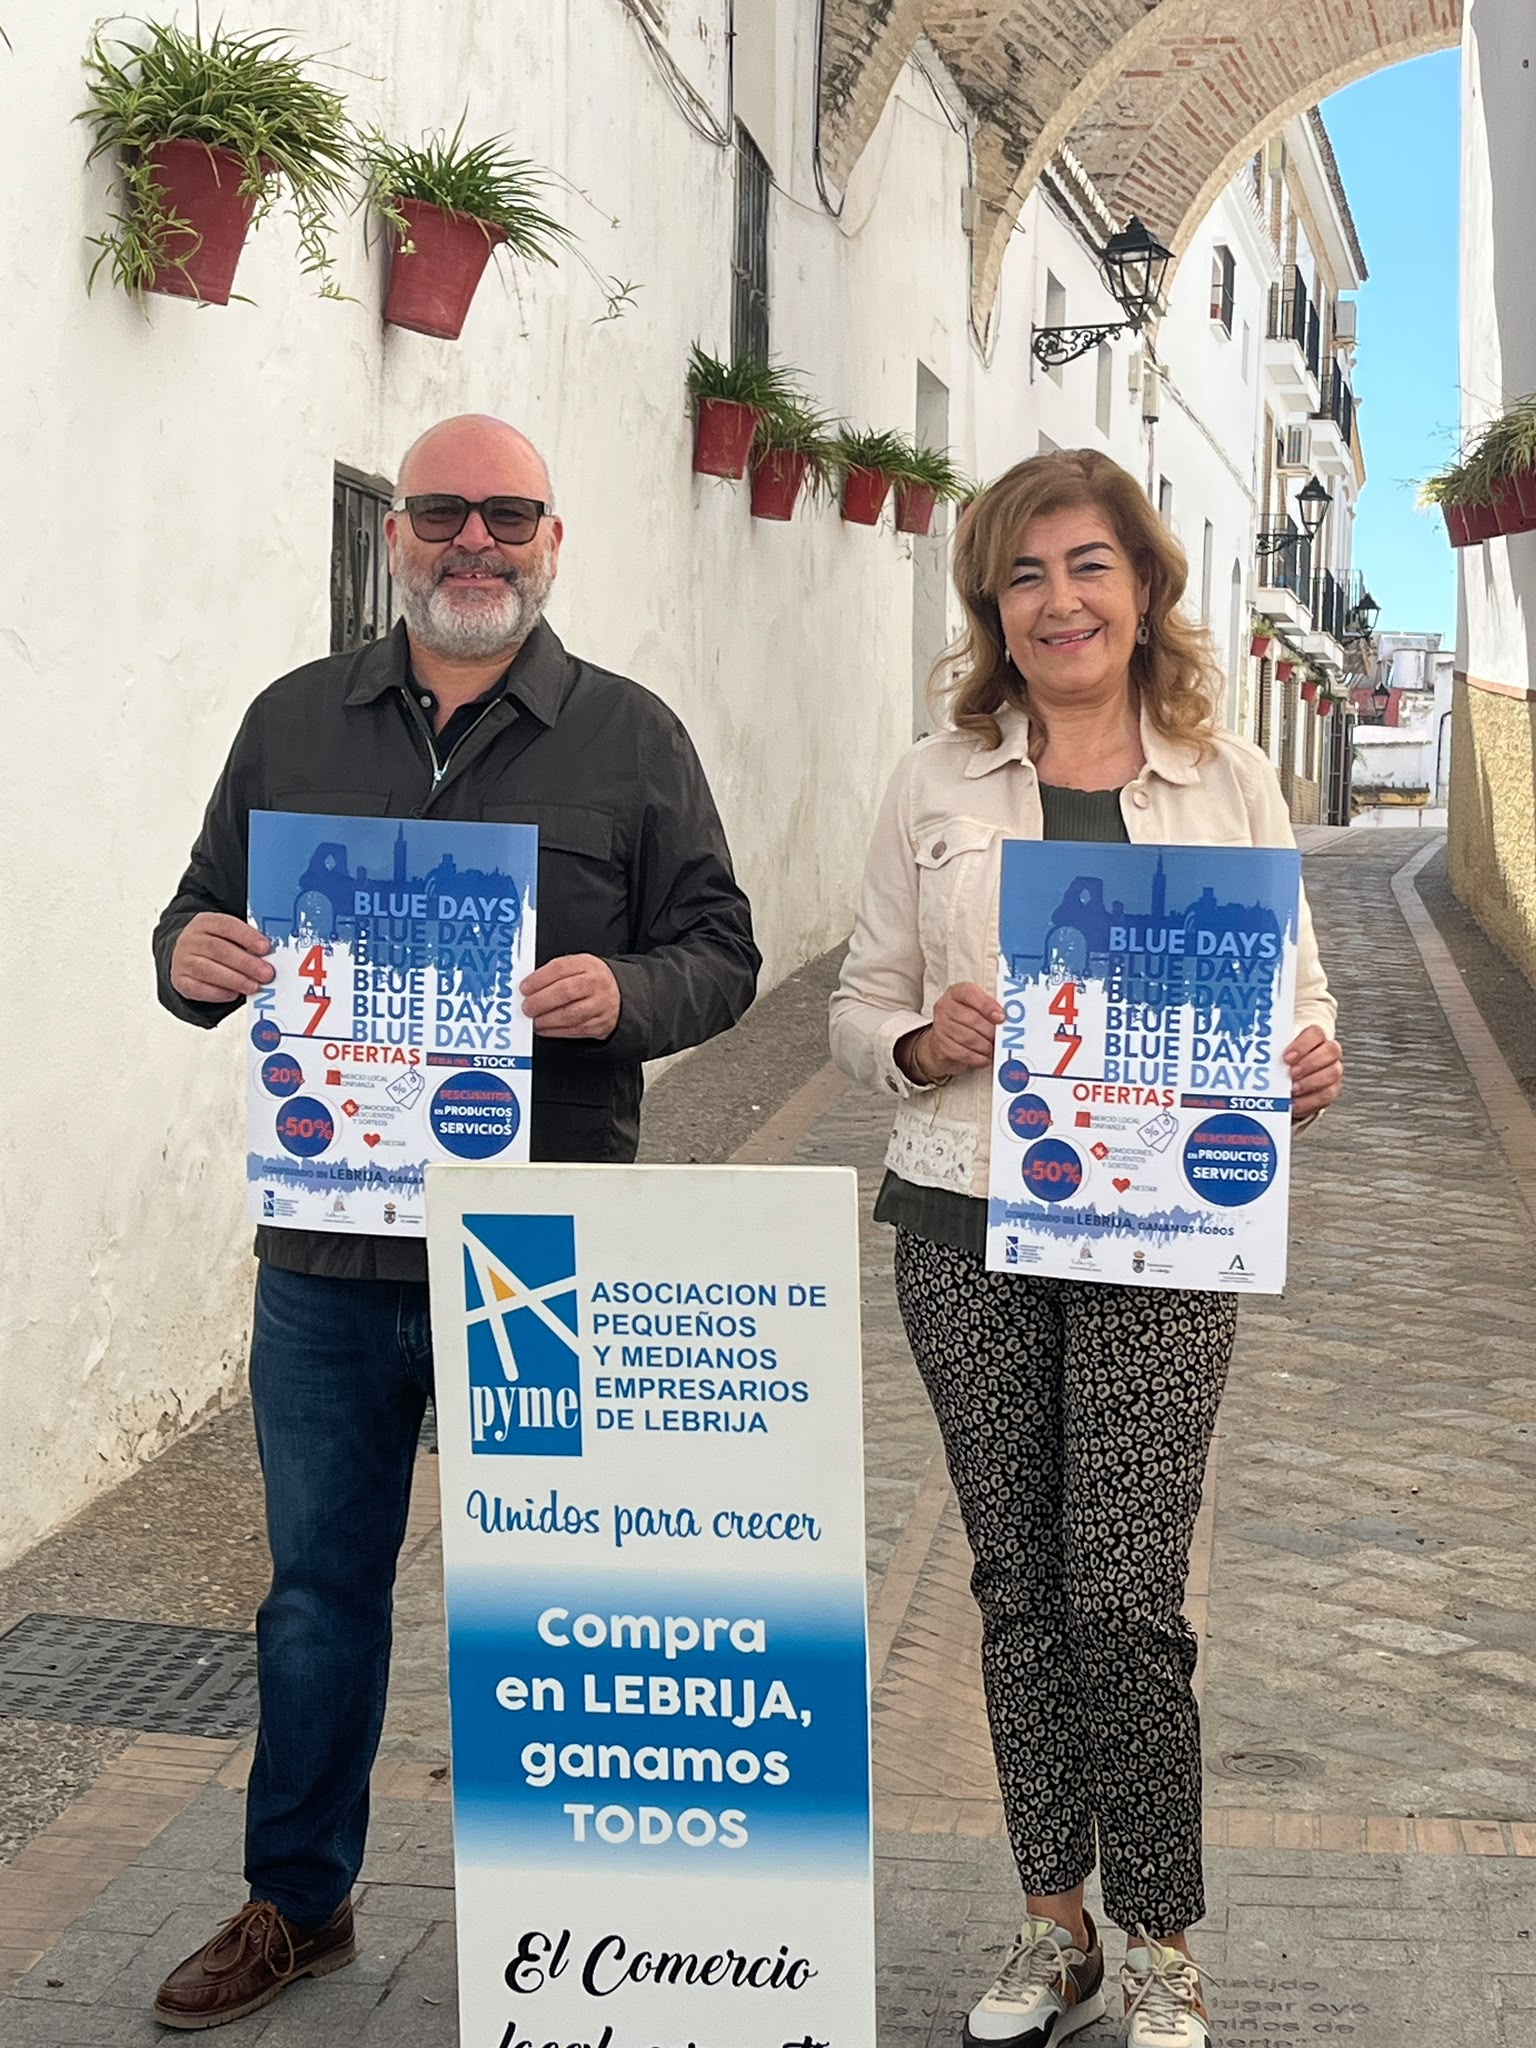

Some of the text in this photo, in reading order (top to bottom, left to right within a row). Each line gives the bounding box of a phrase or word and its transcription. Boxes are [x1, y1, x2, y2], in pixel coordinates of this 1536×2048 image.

[354, 891, 516, 923] BLUE DAYS
[354, 917, 426, 944] BLUE
[438, 921, 514, 948] DAYS
[1109, 926, 1276, 958] BLUE DAYS
[299, 944, 327, 987] 4
[354, 943, 513, 972] BLUE DAYS
[1109, 953, 1274, 983] BLUE DAYS
[353, 969, 425, 995] BLUE
[1108, 979, 1272, 1010] BLUE DAYS
[303, 997, 331, 1037] 7
[353, 994, 512, 1025] BLUE DAYS
[1002, 975, 1027, 1050] NOV
[1048, 982, 1079, 1024] 4
[1106, 1006, 1181, 1033] BLUE
[352, 1020, 512, 1050] BLUE DAYS
[1105, 1033, 1271, 1064] BLUE DAYS
[323, 1043, 421, 1066] OFERTAS
[473, 1056, 516, 1068] STOCK
[1053, 1034, 1082, 1077] 7
[1104, 1059, 1270, 1091] BLUE DAYS
[1073, 1083, 1174, 1107] OFERTAS
[1230, 1097, 1274, 1110] STOCK
[444, 1105, 512, 1117] PRODUCTOS
[277, 1116, 333, 1140] -50%
[439, 1122, 512, 1135] SERVICIOS
[1198, 1149, 1269, 1162] PRODUCTOS
[1023, 1160, 1082, 1184] -50%
[1193, 1167, 1268, 1181] SERVICIOS
[1138, 1222, 1195, 1234] GANAMOS
[1199, 1226, 1235, 1236] TODOS
[591, 1282, 827, 1308] ASOCIACION DE
[592, 1311, 757, 1337] PEQUEÑOS
[593, 1345, 777, 1370] Y MEDIANOS
[595, 1377, 809, 1402] EMPRESARIOS
[471, 1384, 579, 1443] pyme
[597, 1409, 769, 1434] DE LEBRIJA
[466, 1490, 823, 1548] Unidos para crecer
[537, 1607, 767, 1660] Compra
[495, 1673, 812, 1728] en LEBRIJA,
[521, 1741, 791, 1788] ganamos
[563, 1804, 749, 1849] TODOS
[504, 1929, 819, 1998] El Comercio
